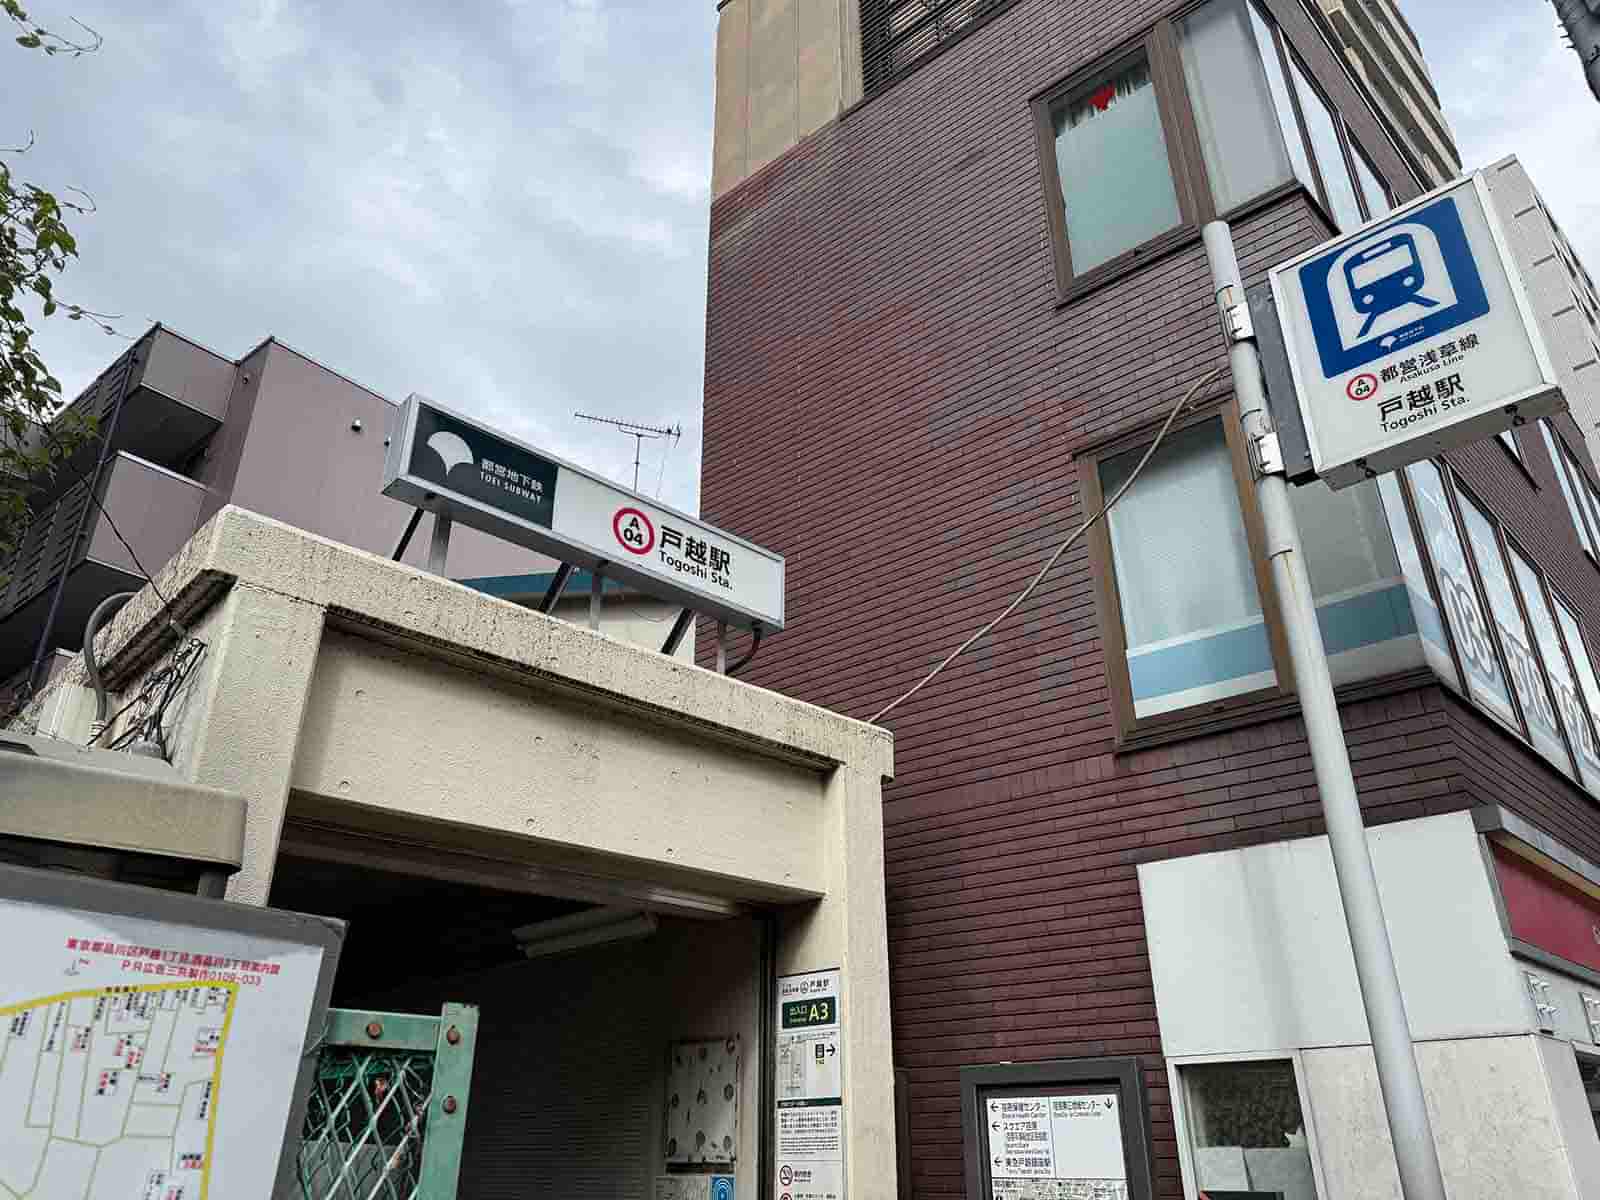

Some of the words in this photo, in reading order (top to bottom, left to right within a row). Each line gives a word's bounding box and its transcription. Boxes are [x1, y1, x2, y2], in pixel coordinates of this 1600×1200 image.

[1380, 333, 1480, 383] 都営浅草線
[1400, 363, 1441, 383] Asakusa
[1443, 354, 1464, 366] Line
[1355, 384, 1370, 395] 04
[1378, 373, 1464, 421] 戸越駅
[1380, 403, 1438, 432] Togoshi
[1441, 395, 1470, 410] Sta.
[481, 458, 543, 493] 都営地下鉄
[504, 481, 542, 505] SUBWAY
[623, 528, 643, 545] 04
[629, 517, 640, 530] A
[660, 525, 730, 576] 戸越駅
[660, 550, 707, 579] Togoshi
[711, 572, 733, 590] Sta.
[809, 1003, 829, 1020] A3
